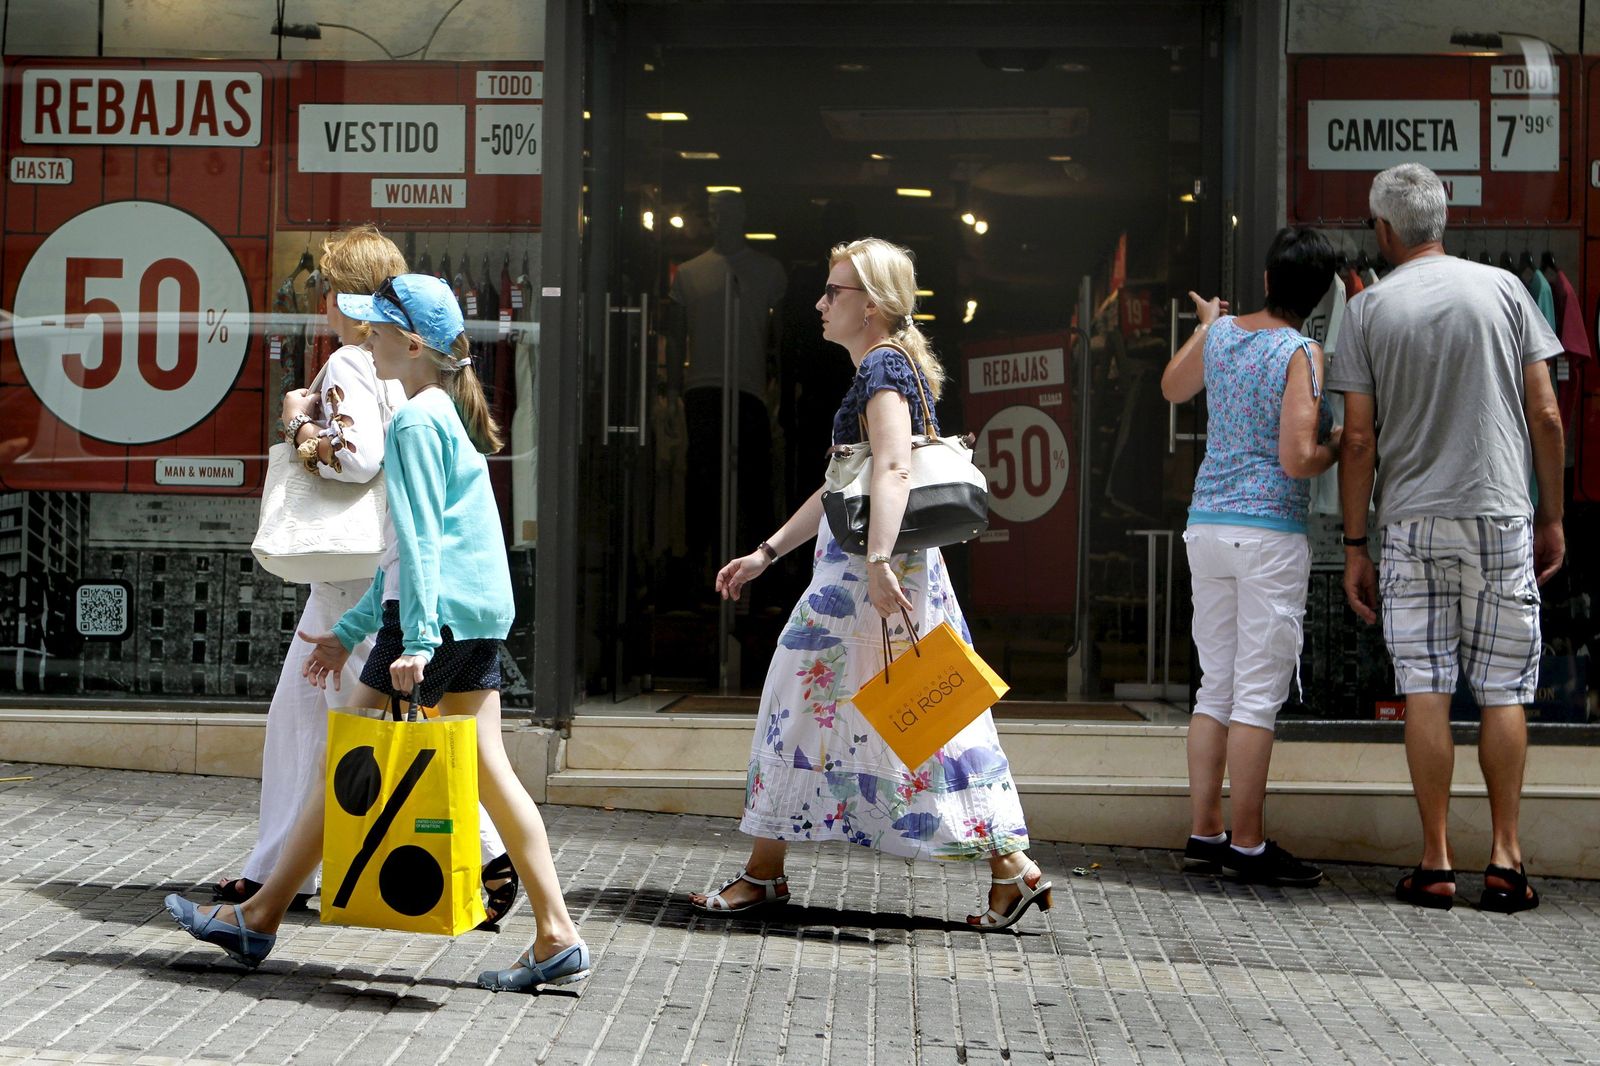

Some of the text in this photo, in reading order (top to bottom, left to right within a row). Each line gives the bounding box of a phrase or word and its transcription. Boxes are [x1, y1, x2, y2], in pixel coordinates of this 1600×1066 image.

[488, 75, 533, 96] TODO
[1503, 68, 1548, 90] TODO
[35, 79, 252, 137] REBAJAS
[324, 121, 439, 154] VESTIDO
[480, 123, 537, 156] -50%
[1327, 118, 1458, 152] CAMISETA
[16, 161, 65, 180] HASTA
[385, 184, 453, 205] WOMAN
[982, 355, 1049, 387] REBAJAS
[164, 465, 234, 479] MAN & WOMAN
